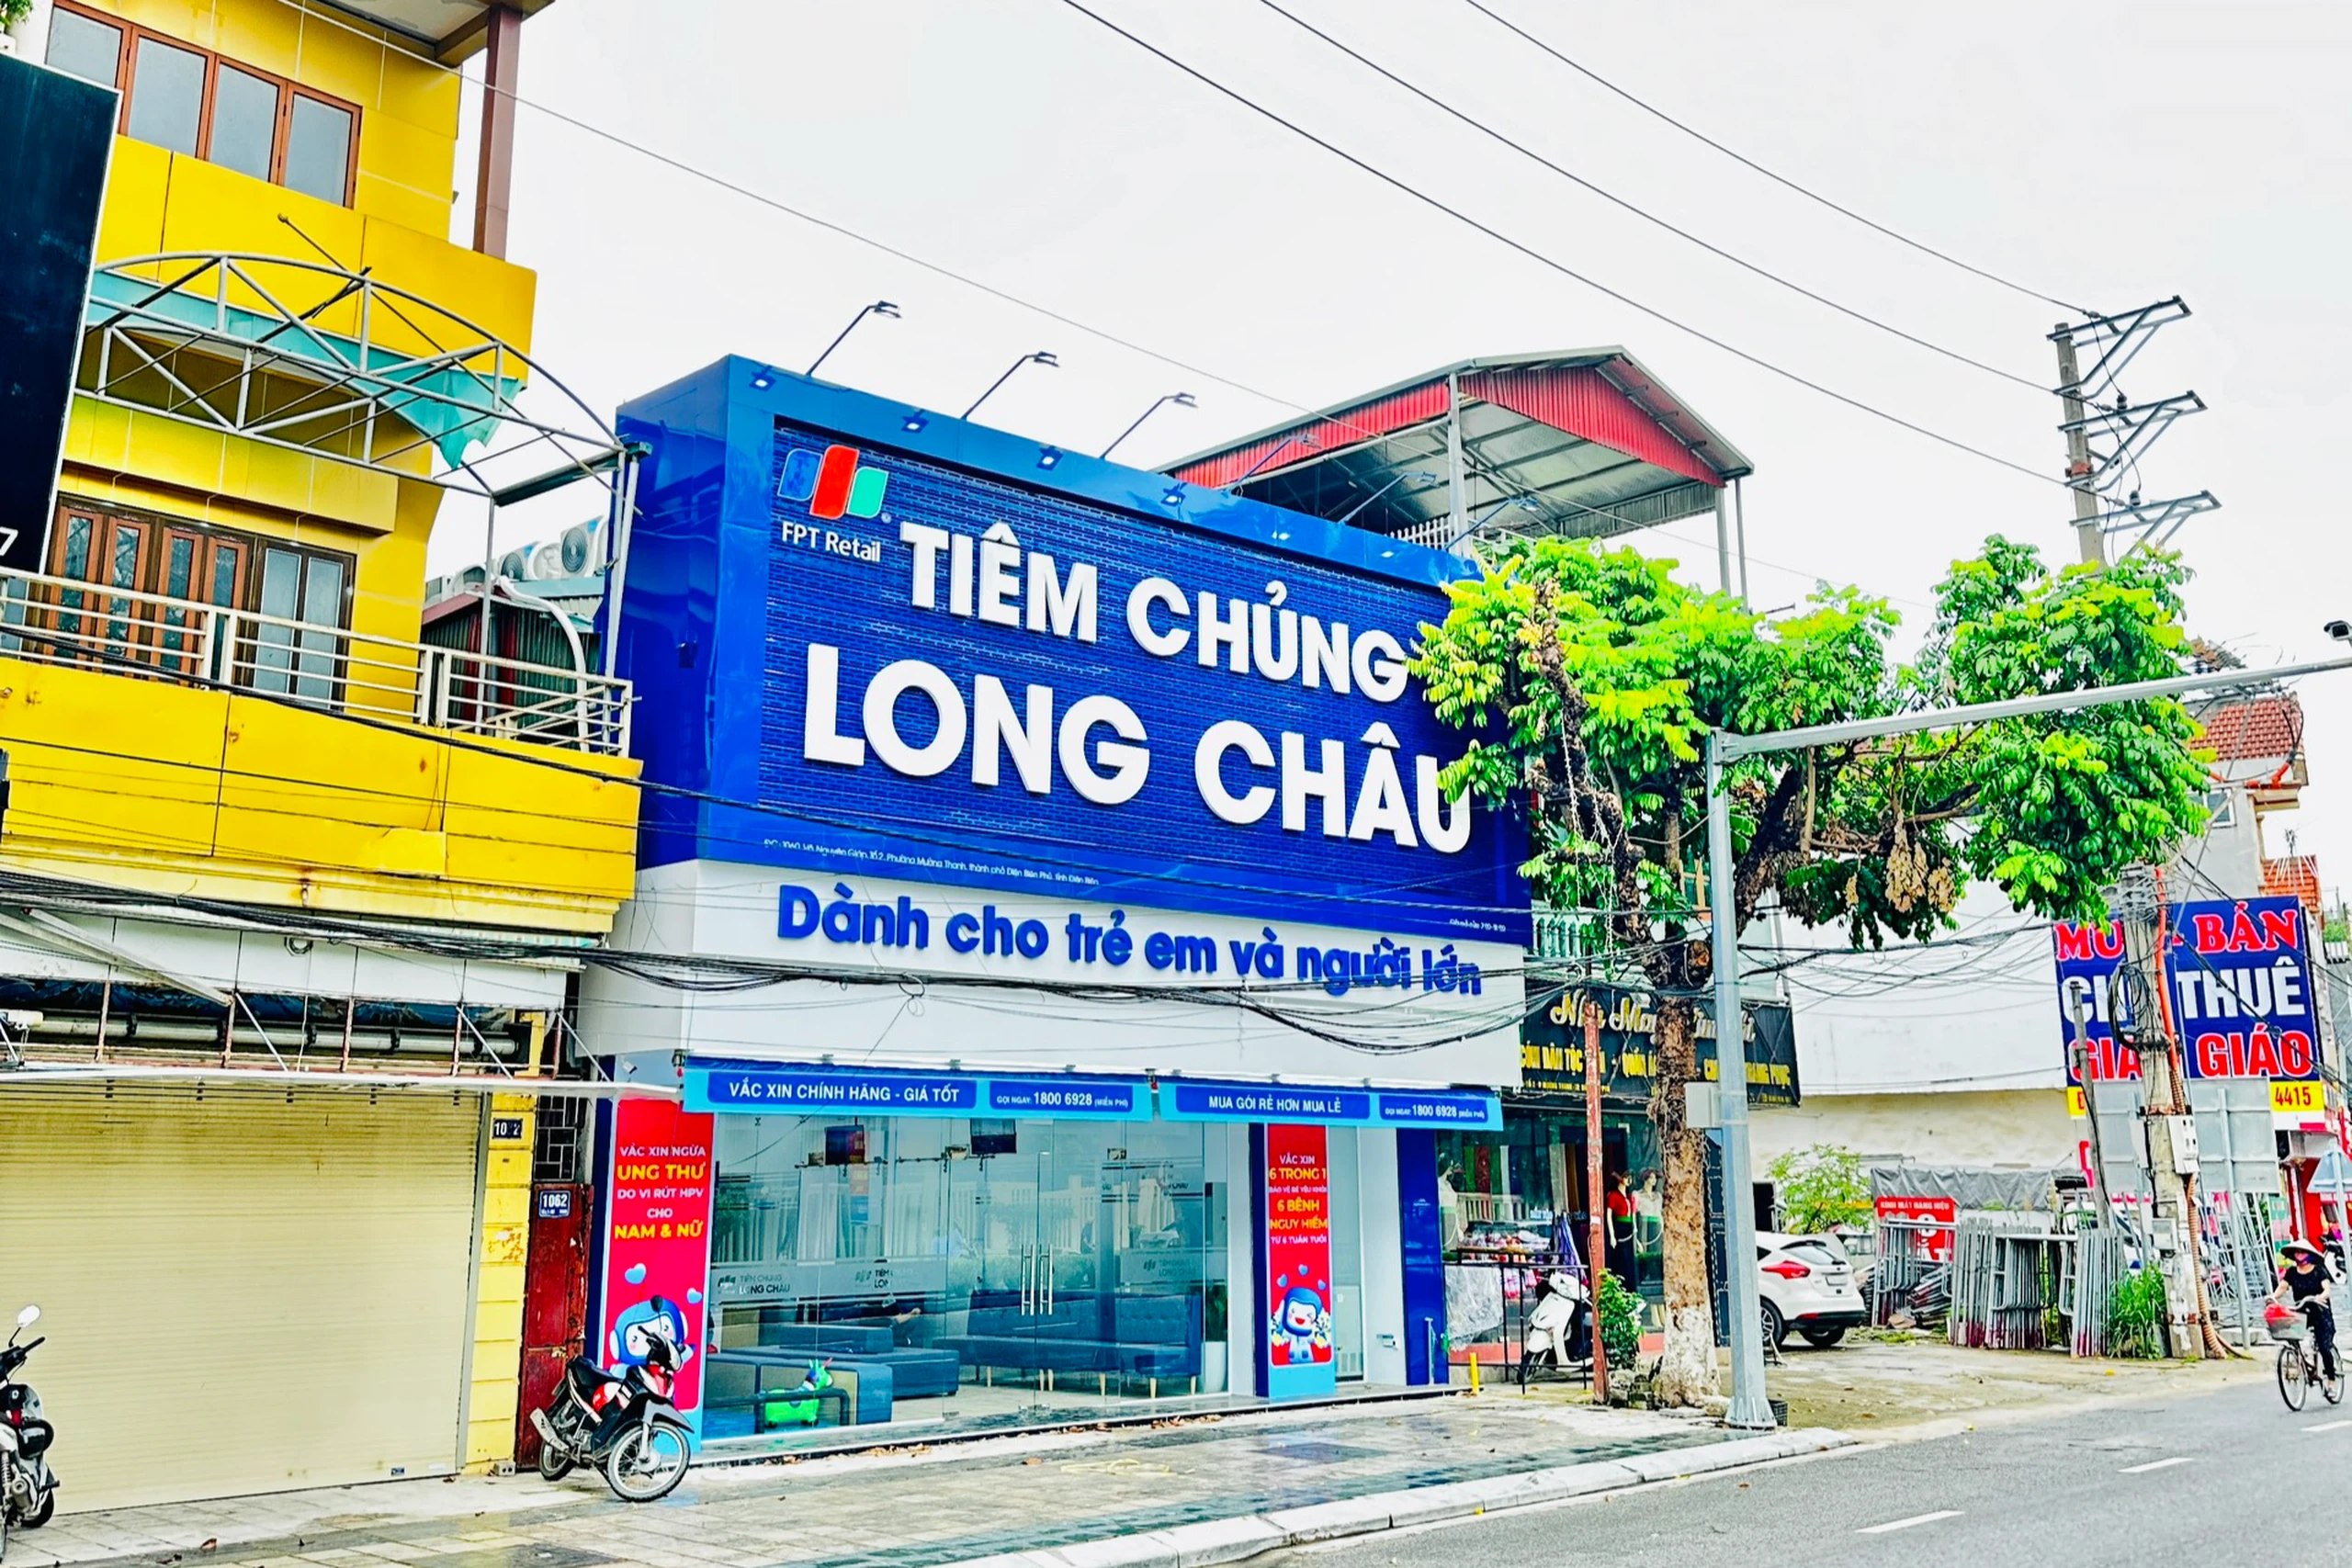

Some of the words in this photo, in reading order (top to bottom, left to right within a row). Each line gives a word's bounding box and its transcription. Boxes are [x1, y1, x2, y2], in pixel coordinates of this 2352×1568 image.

[782, 521, 820, 548] FPT
[826, 531, 881, 562] Retail
[900, 522, 1098, 644] TIÊM
[1126, 577, 1409, 702] CHỦNG
[804, 643, 1149, 805] LONG
[1195, 721, 1471, 853] CHÂU
[778, 882, 929, 950] Dành
[945, 905, 1049, 958] cho
[1066, 909, 1133, 964] trẻ
[1145, 931, 1216, 974] em
[1229, 926, 1284, 978] và
[1296, 937, 1411, 996] người
[1422, 944, 1482, 995] lớn
[2054, 920, 2125, 960] MU
[2062, 973, 2132, 1023] CH
[2176, 956, 2305, 1020] THUÊ
[2196, 1023, 2313, 1079] GIÁO
[729, 1077, 762, 1098] VẮC
[766, 1083, 792, 1099] XIN
[797, 1081, 844, 1100] CHÍNH
[849, 1083, 890, 1101] HÃNG
[904, 1084, 929, 1102] GIÁ
[933, 1083, 959, 1102] TỐT
[1034, 1091, 1061, 1105] 1800
[1065, 1092, 1092, 1106] 6928
[2275, 1086, 2312, 1107] 4415
[1209, 1096, 1233, 1109] MUA
[1236, 1094, 1256, 1110] GÓI
[1259, 1093, 1273, 1111] RẺ
[1277, 1098, 1299, 1111] HƠN
[1303, 1100, 1325, 1112] MUA
[1328, 1096, 1341, 1113] LẺ
[1412, 1104, 1433, 1117] 1800
[1435, 1104, 1457, 1118] 6928
[494, 1122, 520, 1135] 102
[649, 1146, 669, 1157] XIN
[672, 1144, 706, 1157] NGỪA
[1299, 1155, 1316, 1165] XIN
[617, 1164, 660, 1180] UNG
[665, 1161, 707, 1180] THƯ
[1270, 1167, 1277, 1180] 6
[1278, 1167, 1319, 1180] TRONG
[542, 1193, 568, 1207] 1062
[617, 1189, 636, 1200] DO
[639, 1189, 650, 1199] VI
[653, 1185, 677, 1199] RÚT
[679, 1188, 704, 1198] HPV
[647, 1208, 673, 1219] CHO
[1277, 1199, 1284, 1212] 6
[1287, 1196, 1319, 1213] BỆNH
[615, 1224, 656, 1239] NAM
[660, 1224, 672, 1238] &
[676, 1219, 703, 1237] NỮ
[1270, 1218, 1300, 1230] NGUY
[1301, 1214, 1329, 1229] HIỂM
